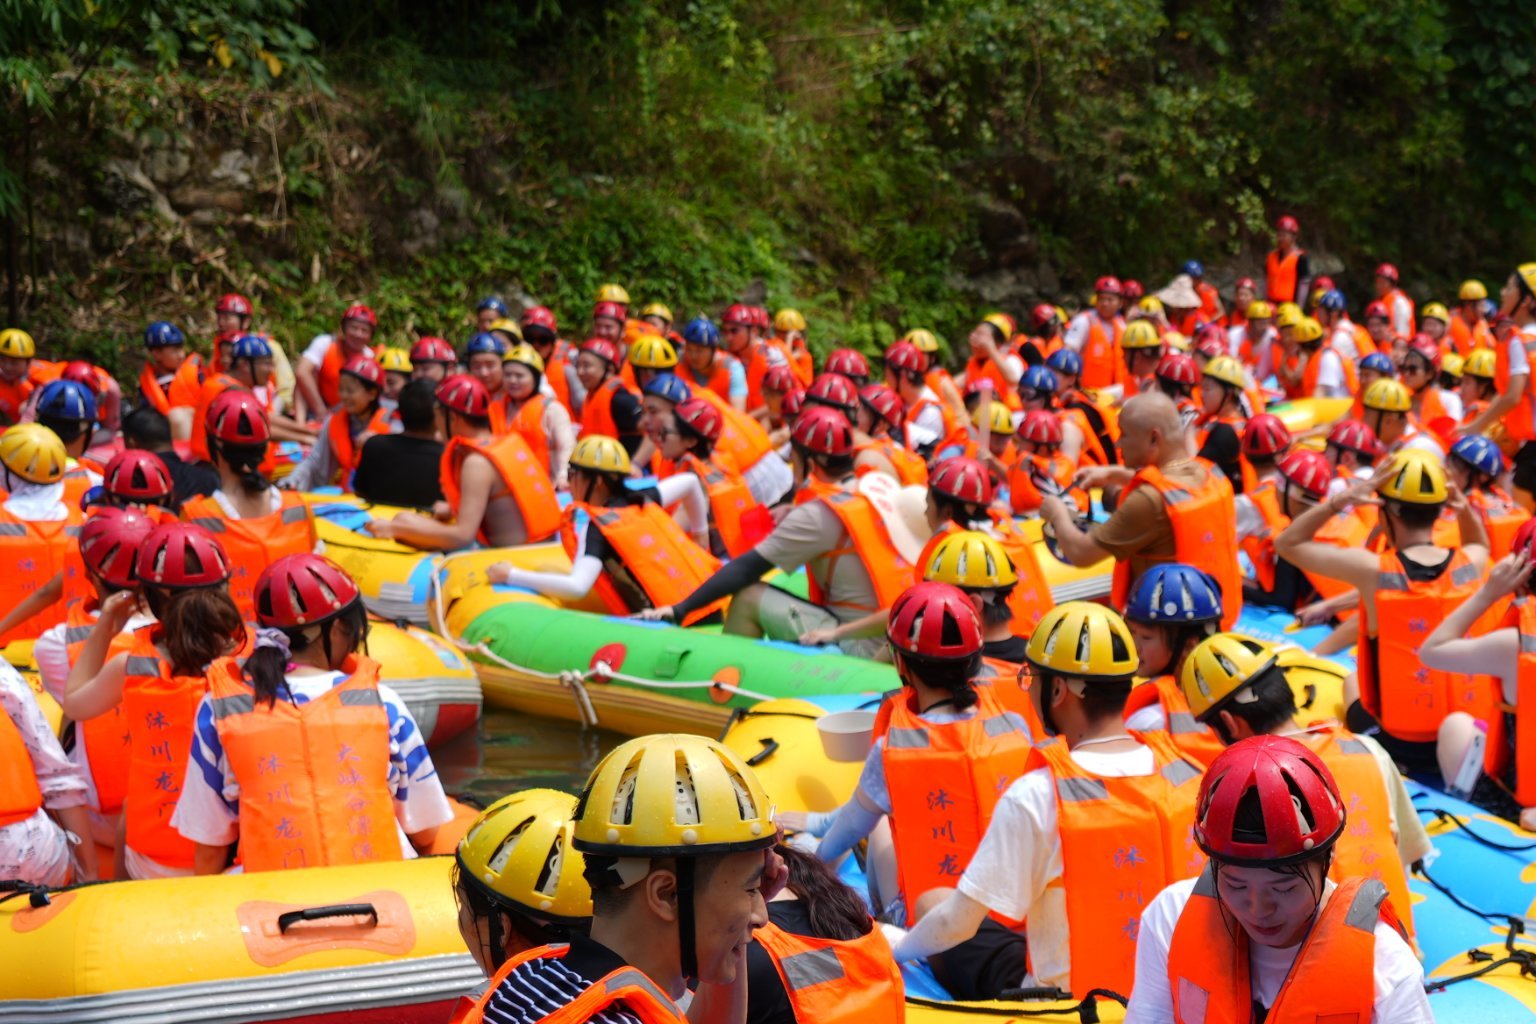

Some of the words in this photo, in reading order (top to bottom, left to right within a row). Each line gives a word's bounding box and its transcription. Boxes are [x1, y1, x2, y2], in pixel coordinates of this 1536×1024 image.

[258, 754, 307, 869] 沐川龙门
[1347, 792, 1382, 880] 大峡谷
